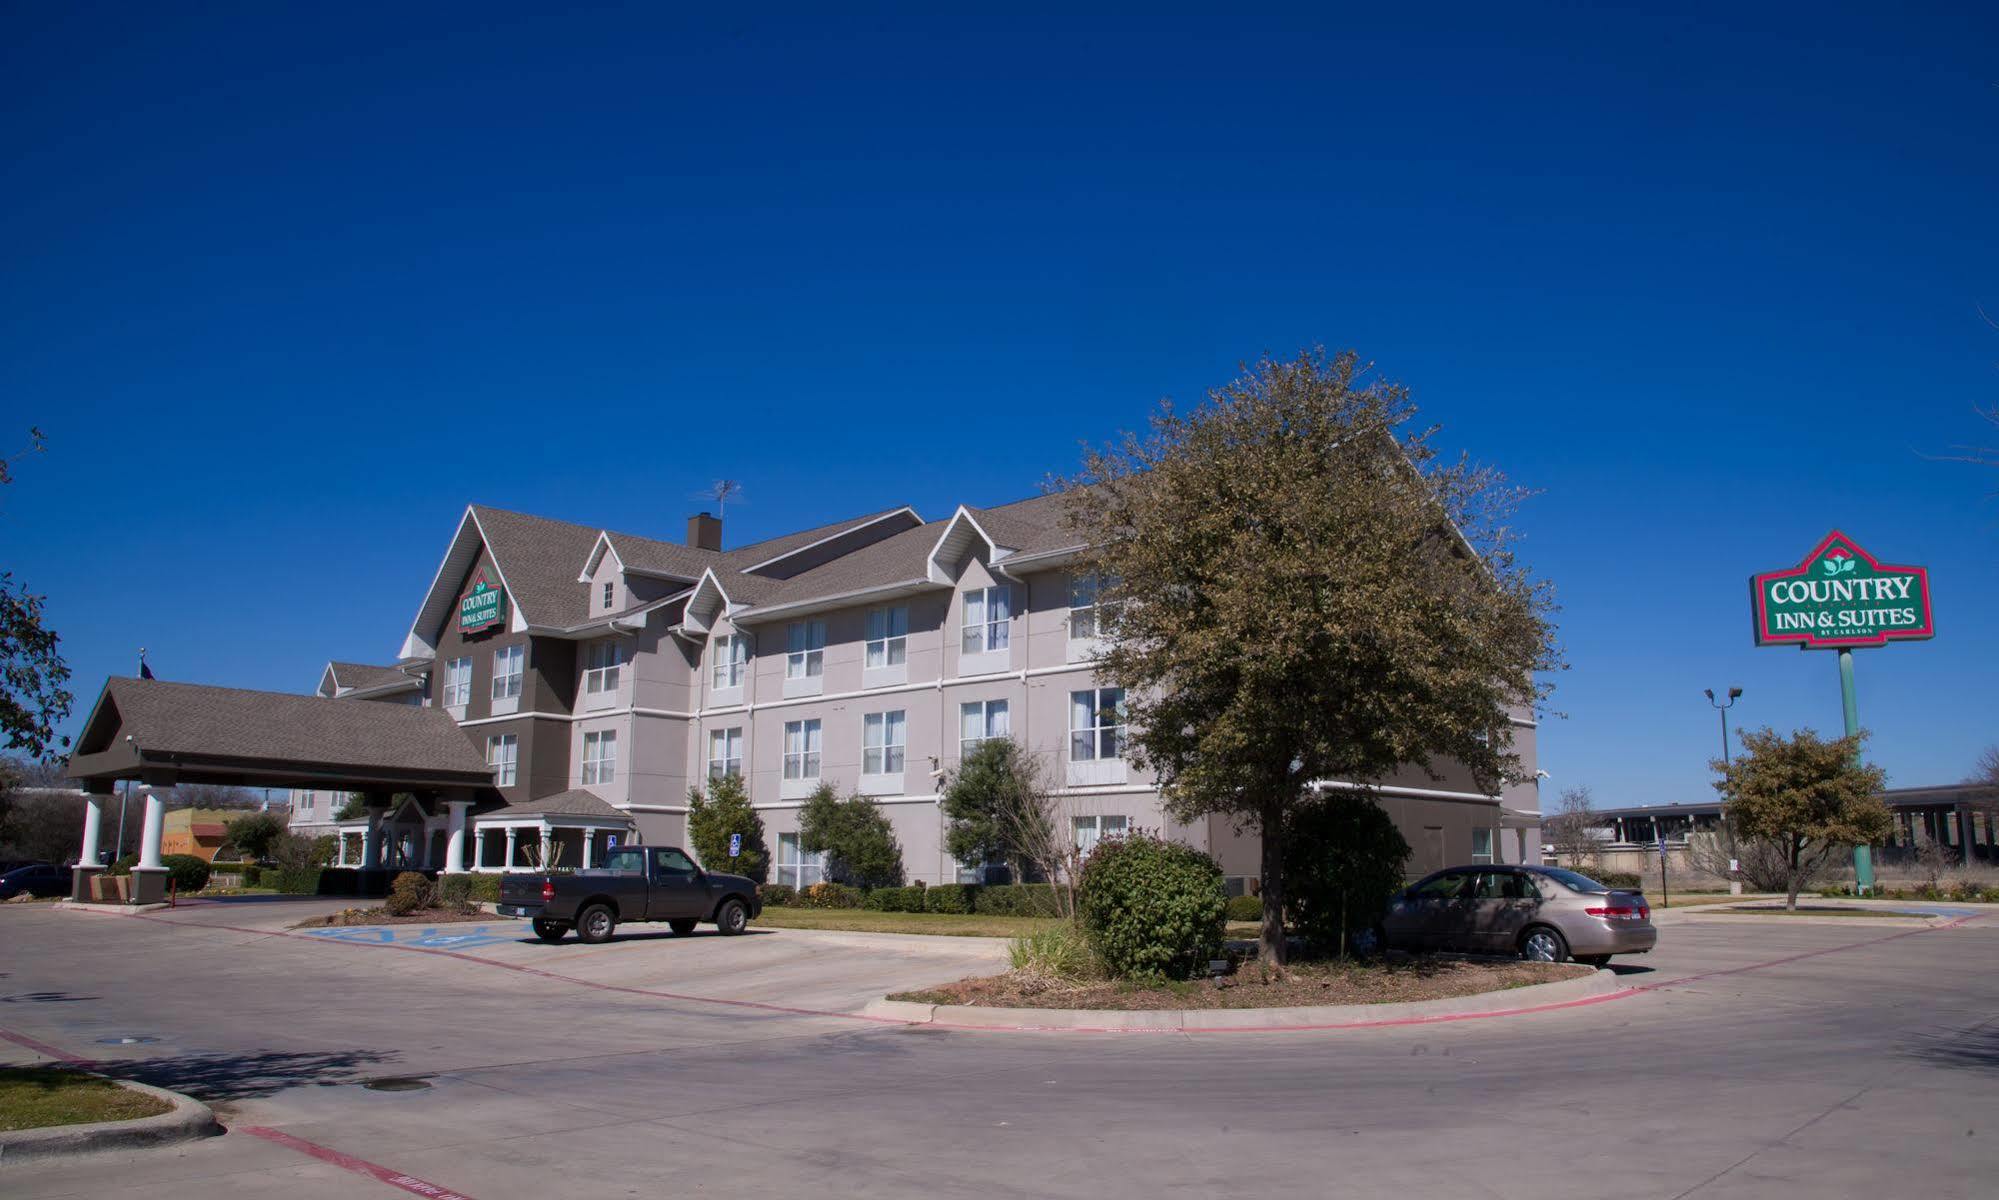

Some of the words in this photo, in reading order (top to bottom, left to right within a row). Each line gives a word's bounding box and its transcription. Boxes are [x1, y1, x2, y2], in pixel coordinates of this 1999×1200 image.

[463, 590, 498, 611] COUNTRY
[1771, 576, 1914, 604] COUNTRY
[1775, 612, 1815, 630] INN
[1838, 607, 1917, 628] SUITES
